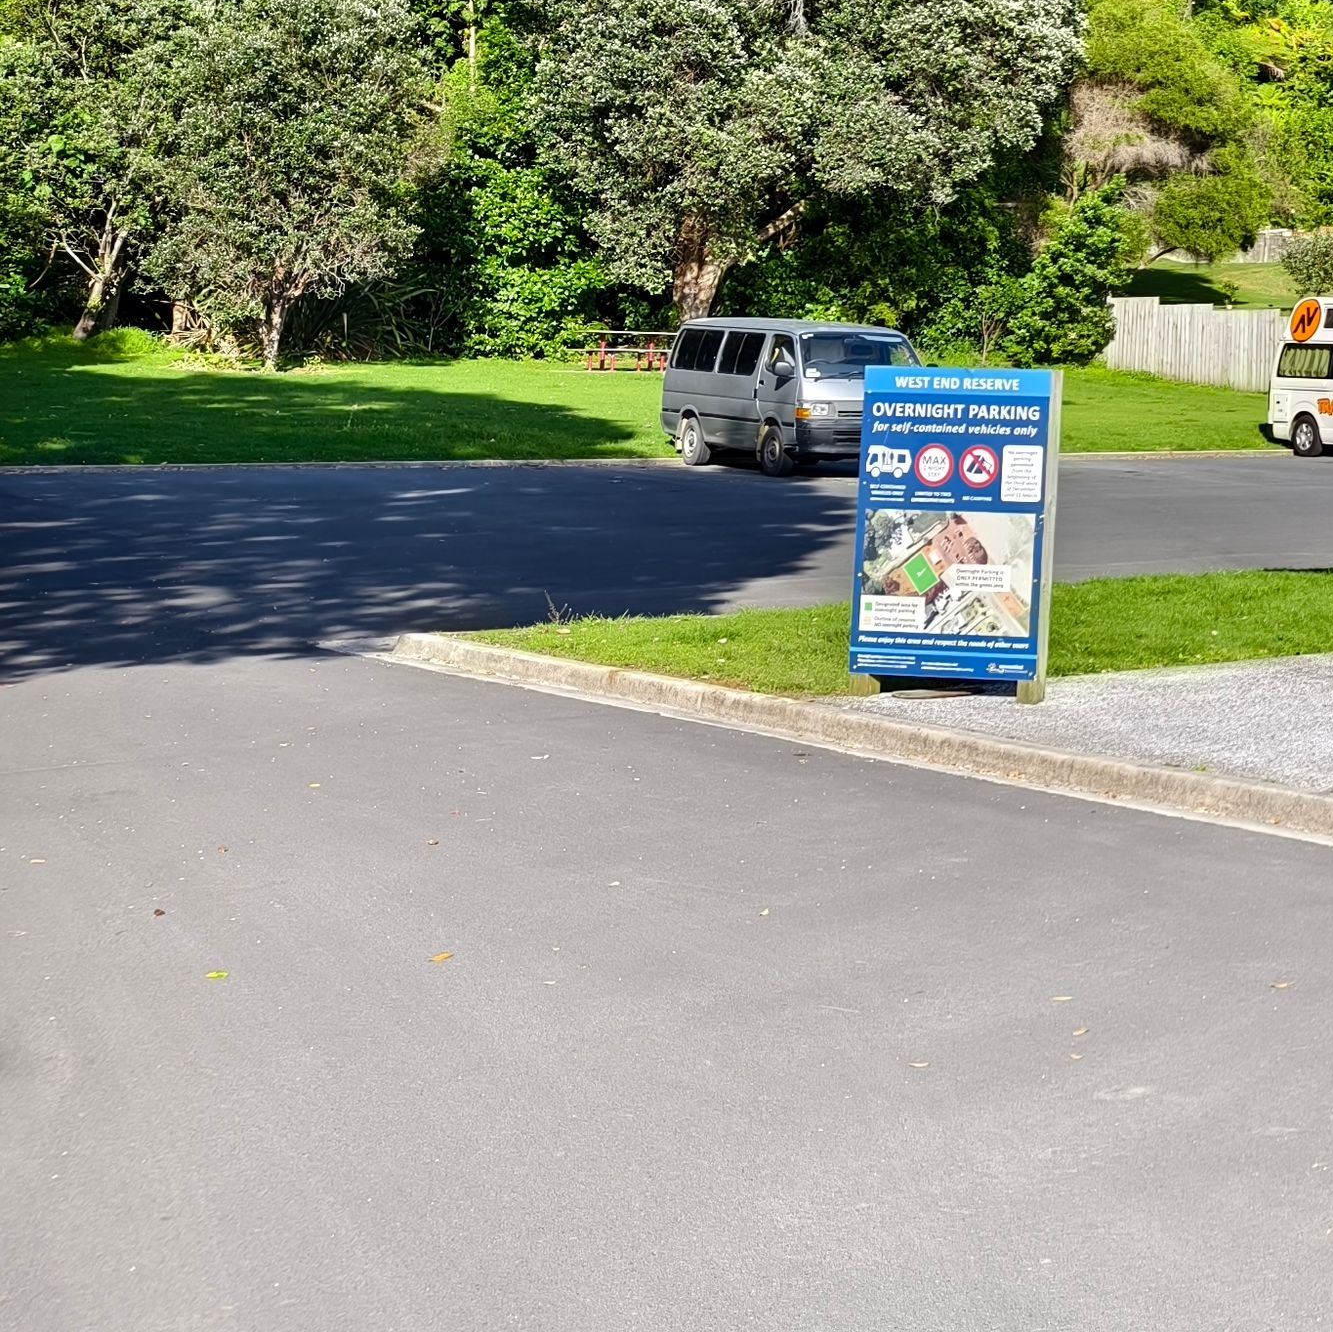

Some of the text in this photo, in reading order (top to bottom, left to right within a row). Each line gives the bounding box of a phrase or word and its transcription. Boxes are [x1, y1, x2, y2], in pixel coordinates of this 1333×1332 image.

[895, 376, 1020, 391] WEST END RESERVE
[872, 401, 1041, 421] OVERNIGHT PARKING
[872, 421, 1038, 438] for self-contained vehicles only
[922, 455, 946, 465] MAX
